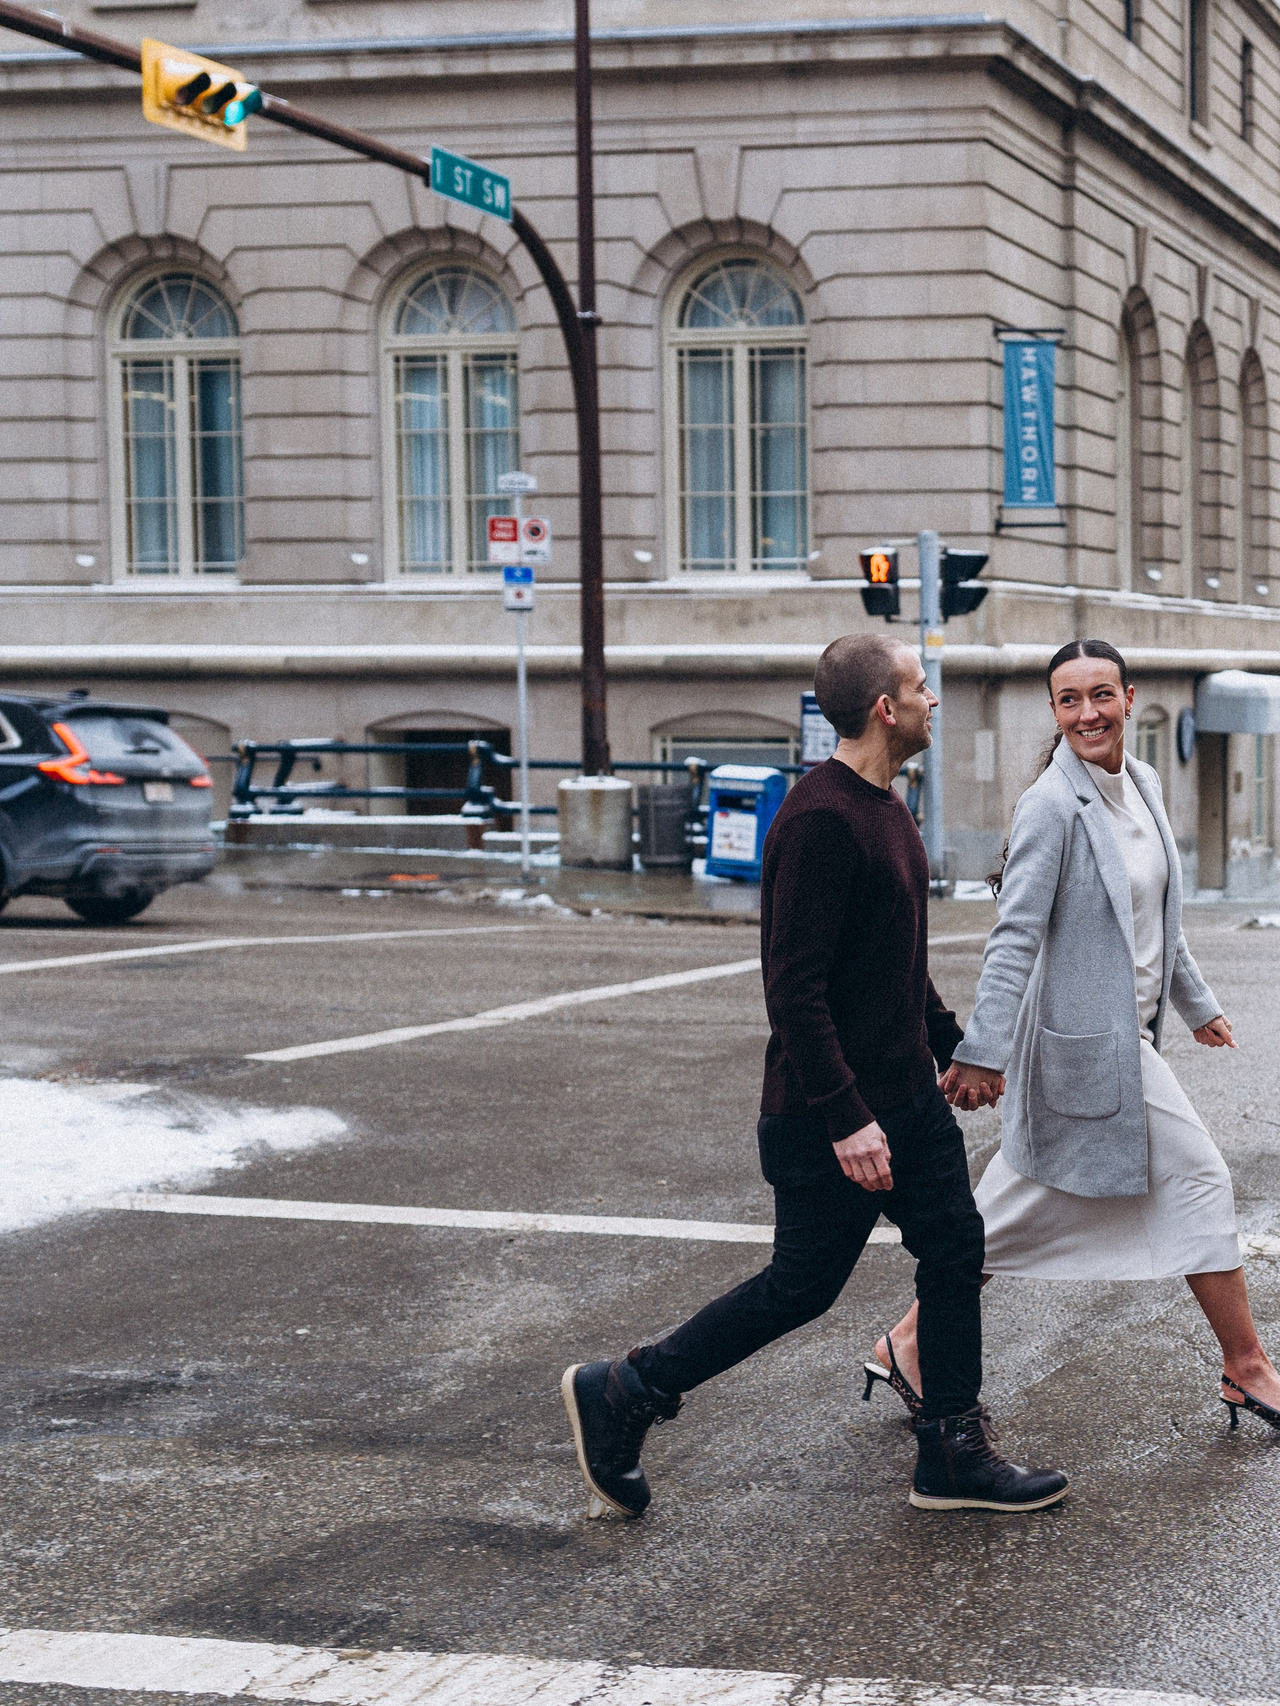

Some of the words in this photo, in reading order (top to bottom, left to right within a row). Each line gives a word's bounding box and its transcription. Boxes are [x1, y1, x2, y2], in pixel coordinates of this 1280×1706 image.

[435, 158, 441, 184] 1
[454, 166, 473, 194] ST
[483, 177, 506, 210] SW
[1021, 347, 1039, 501] HAWTHORN
